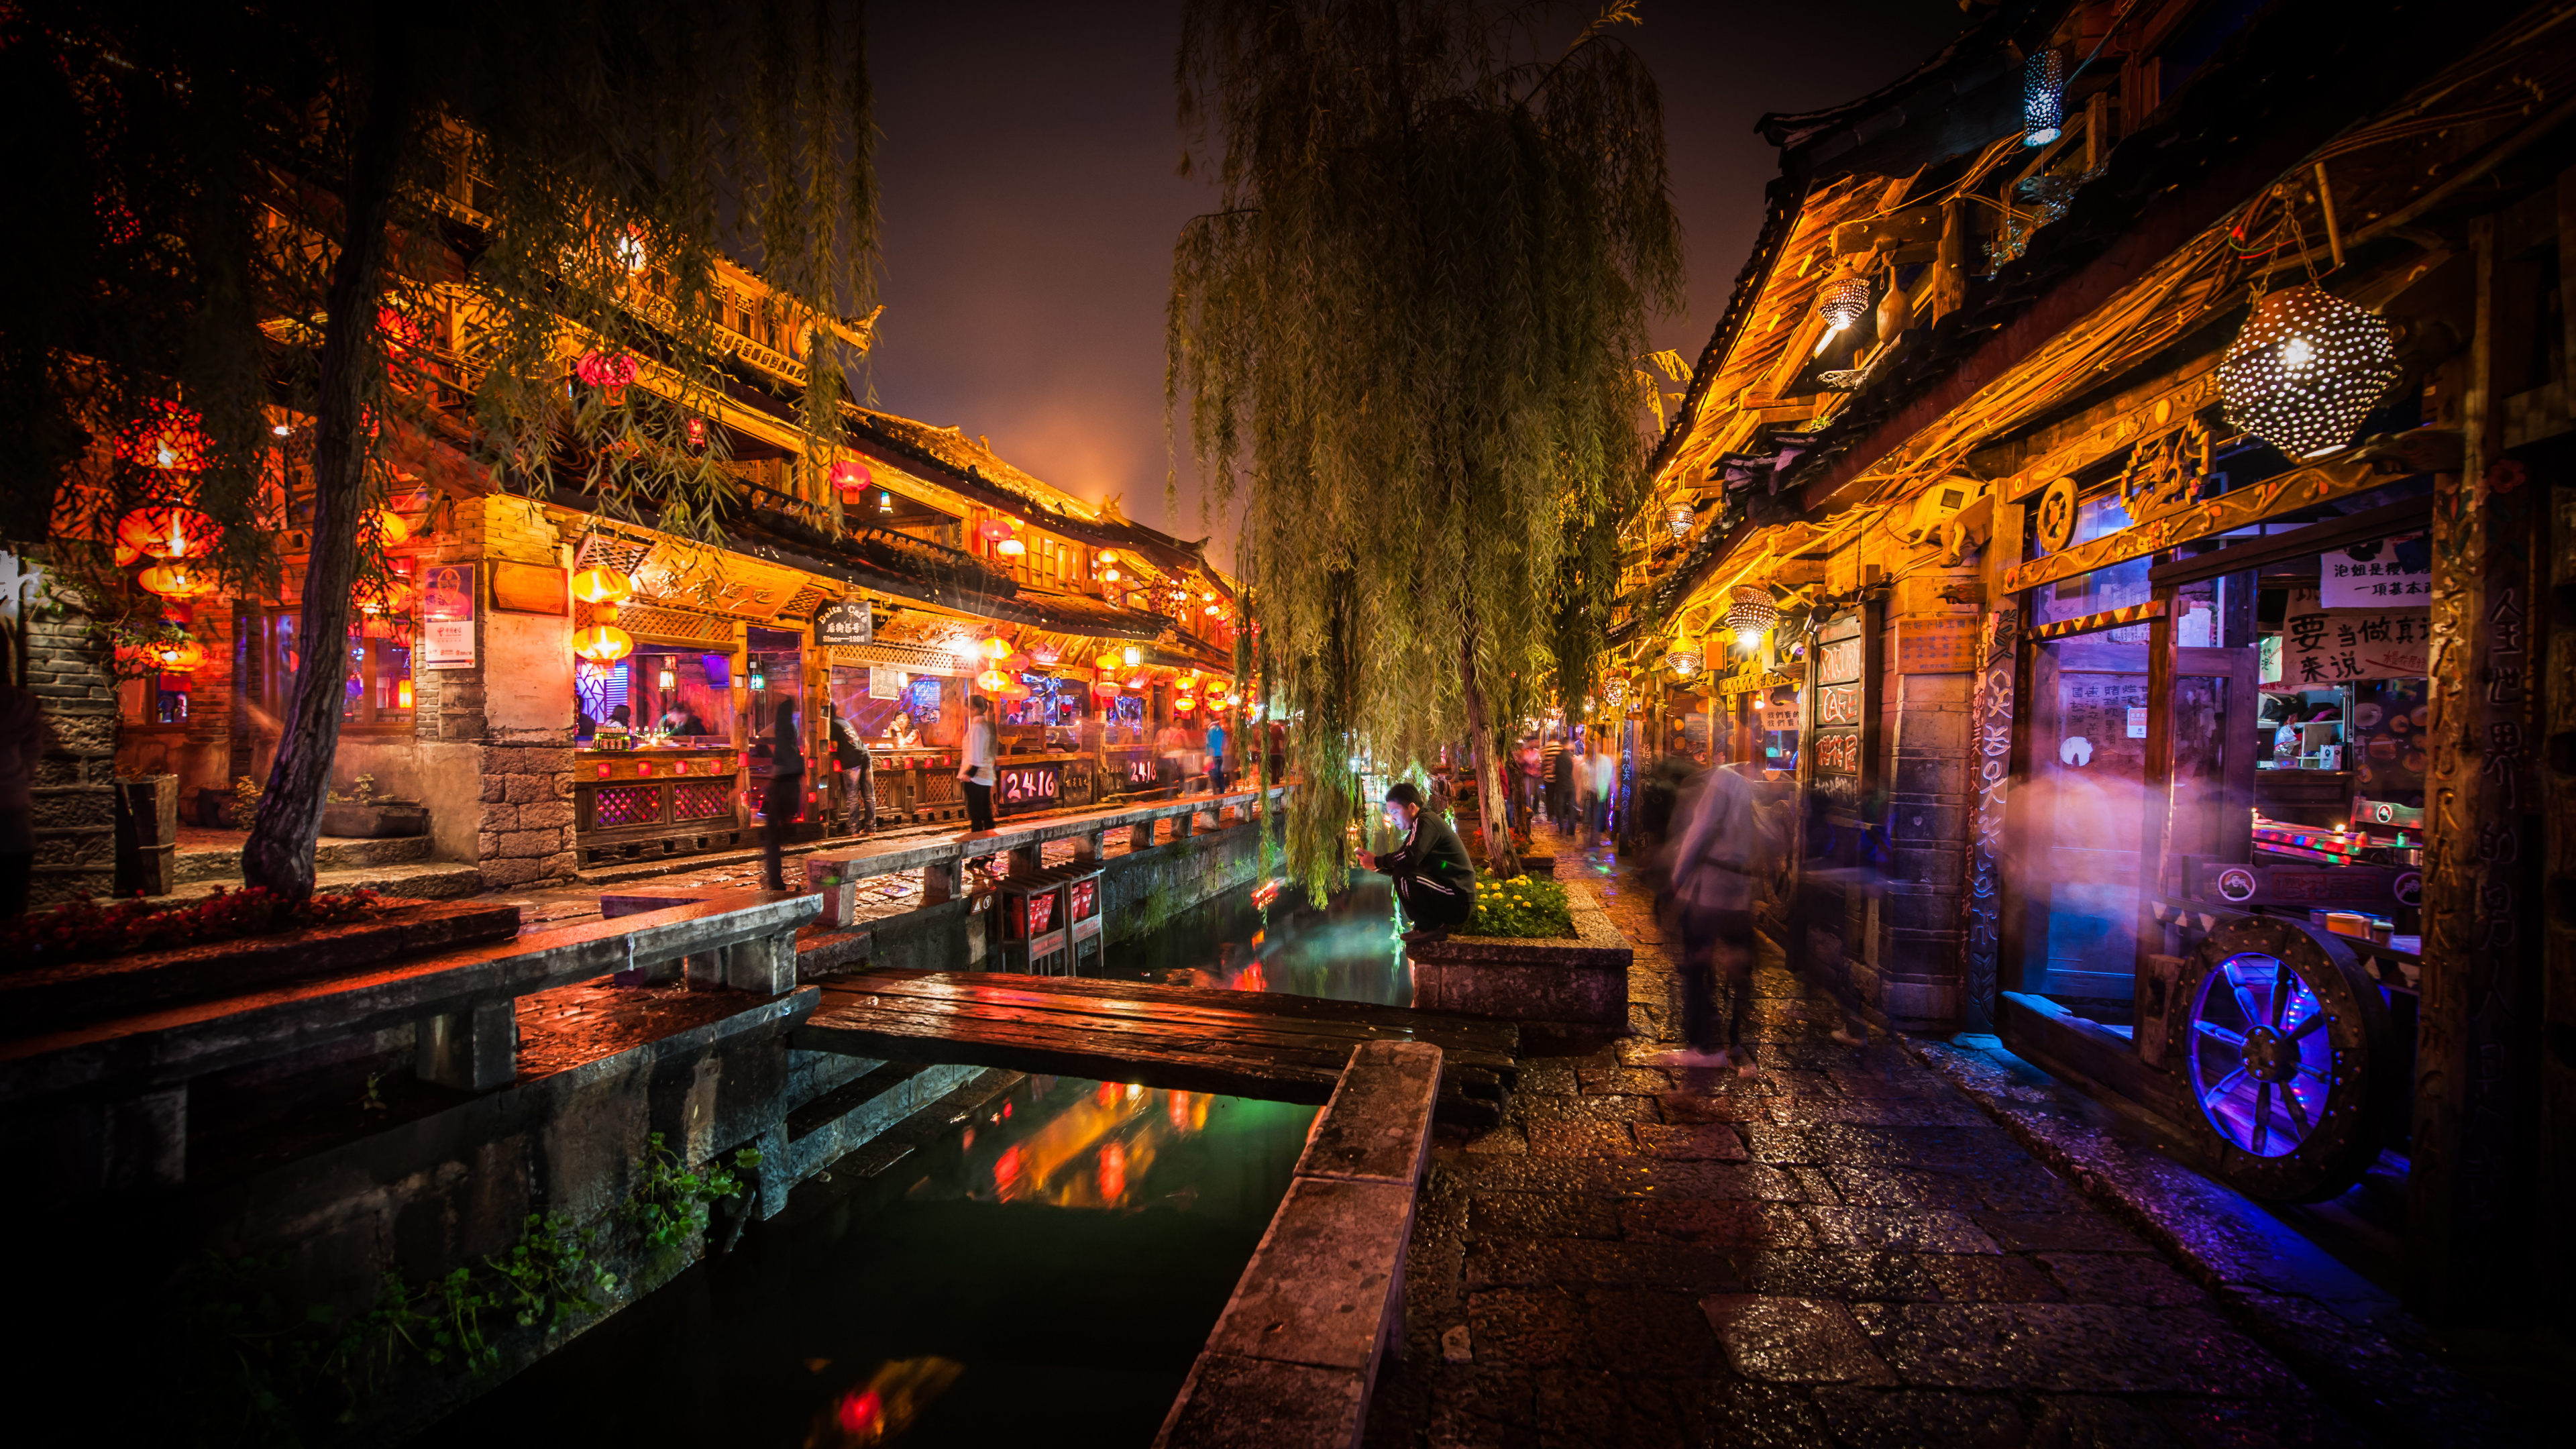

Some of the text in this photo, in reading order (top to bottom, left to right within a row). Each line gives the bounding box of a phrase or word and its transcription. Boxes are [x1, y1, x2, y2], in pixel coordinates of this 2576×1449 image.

[818, 606, 843, 625] Delta
[1024, 630, 1083, 657] 2416
[2300, 650, 2365, 682] 来说
[1823, 687, 1858, 723] CAFE
[1007, 770, 1055, 799] 2416
[1130, 761, 1157, 782] 2416
